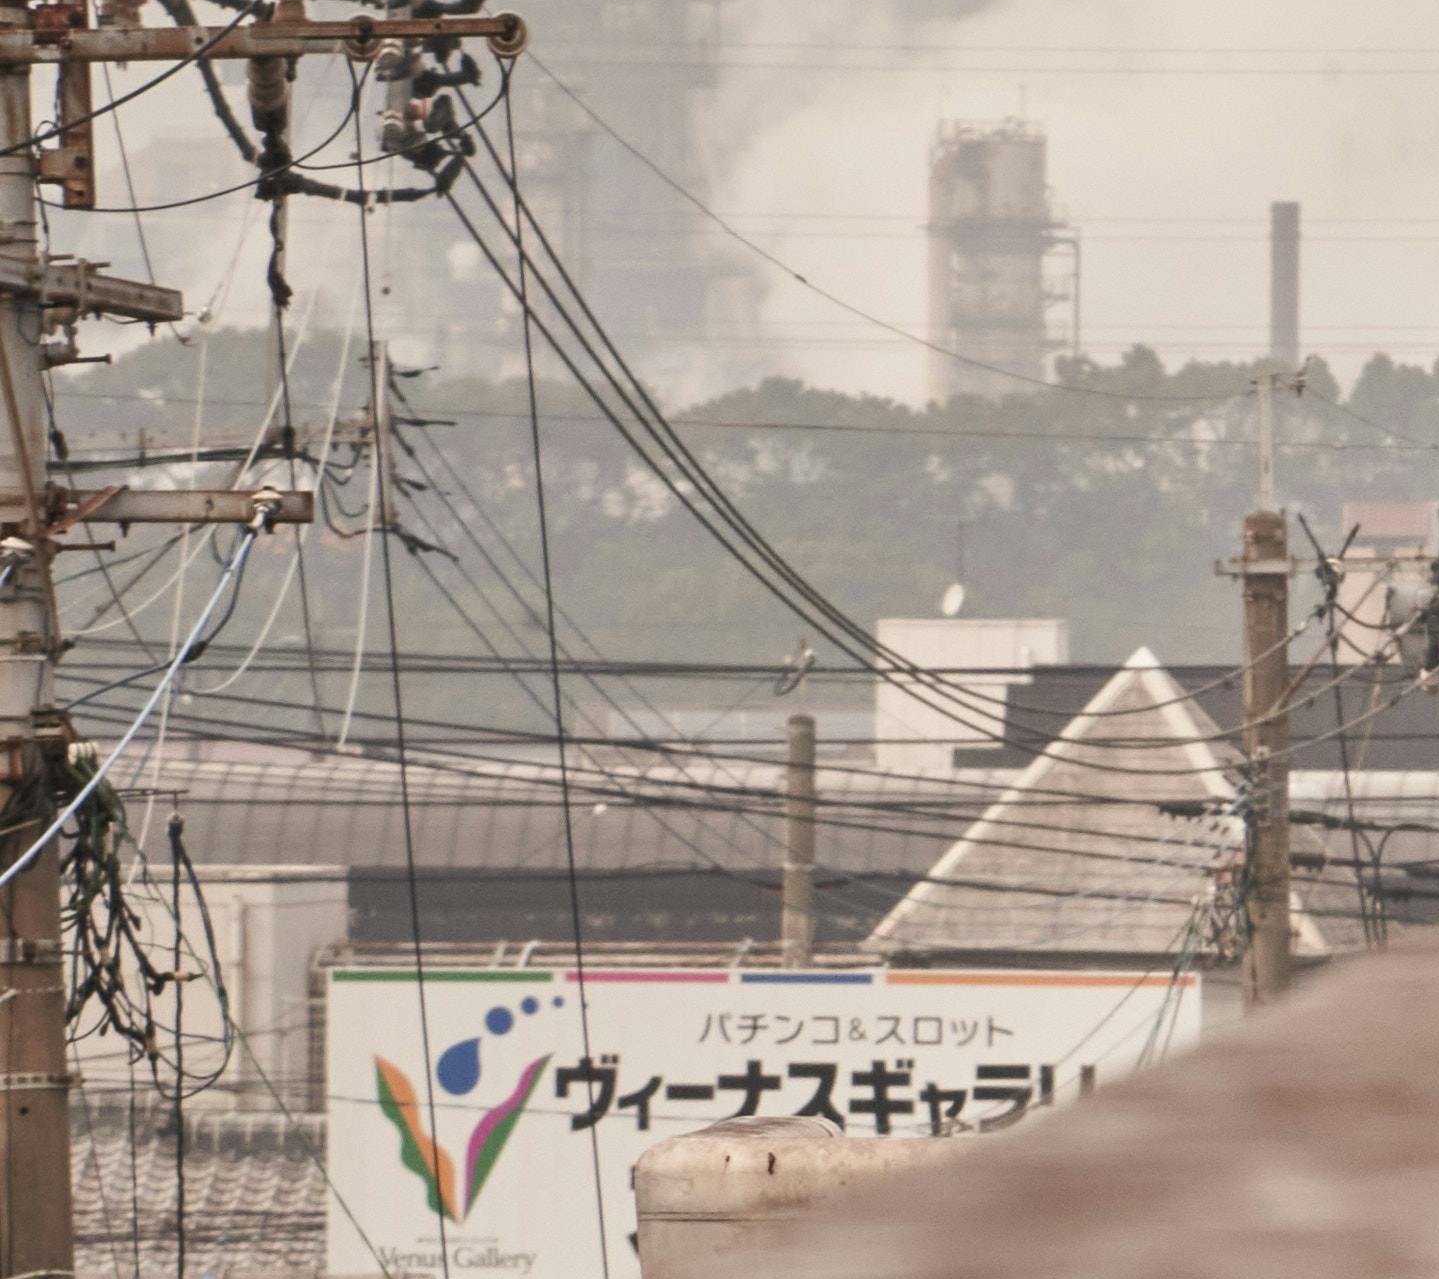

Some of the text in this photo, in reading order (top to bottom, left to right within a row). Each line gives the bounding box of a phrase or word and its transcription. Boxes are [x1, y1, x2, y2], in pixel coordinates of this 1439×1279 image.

[698, 1012, 1015, 1047] パチンコ&スロット
[453, 1245, 537, 1276] Gallery
